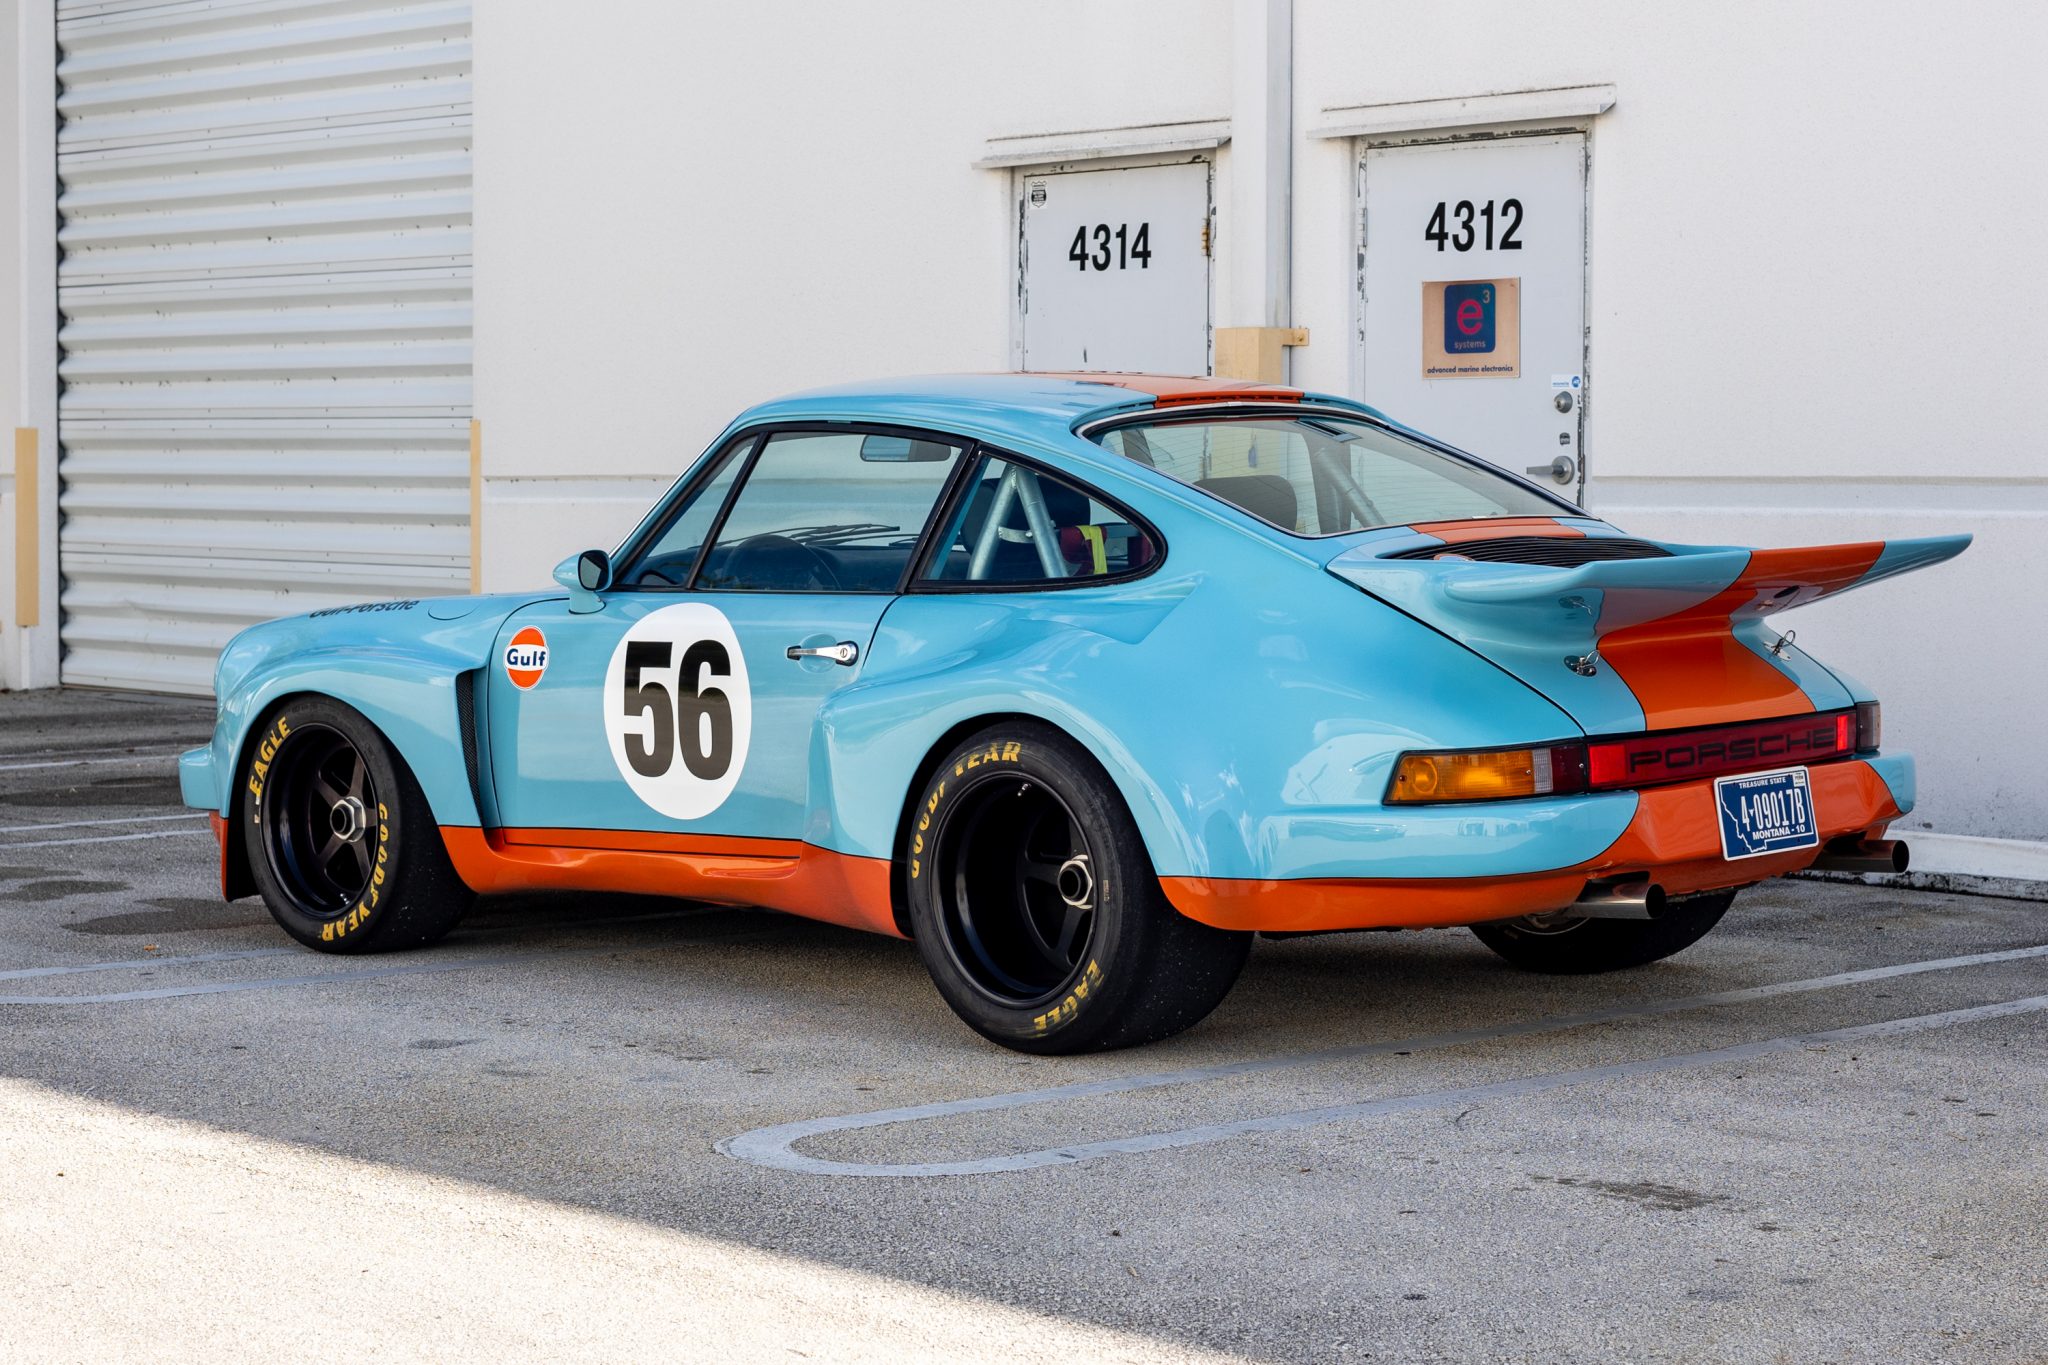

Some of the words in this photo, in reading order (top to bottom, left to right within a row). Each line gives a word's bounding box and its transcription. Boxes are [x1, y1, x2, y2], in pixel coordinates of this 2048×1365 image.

[1425, 198, 1523, 252] 4312
[1069, 222, 1152, 271] 4314
[1454, 340, 1486, 350] systems
[1427, 366, 1457, 374] advanced
[1458, 365, 1480, 373] marine
[1481, 364, 1514, 372] electronics
[506, 649, 546, 667] Gulf
[623, 639, 733, 780] 56
[249, 716, 291, 798] EAGLE
[1630, 727, 1835, 774] PORSCHE
[1739, 779, 1769, 789] TREASURE
[1769, 777, 1787, 785] STATE
[1752, 826, 1791, 840] MONTANA
[1796, 825, 1806, 833] 10
